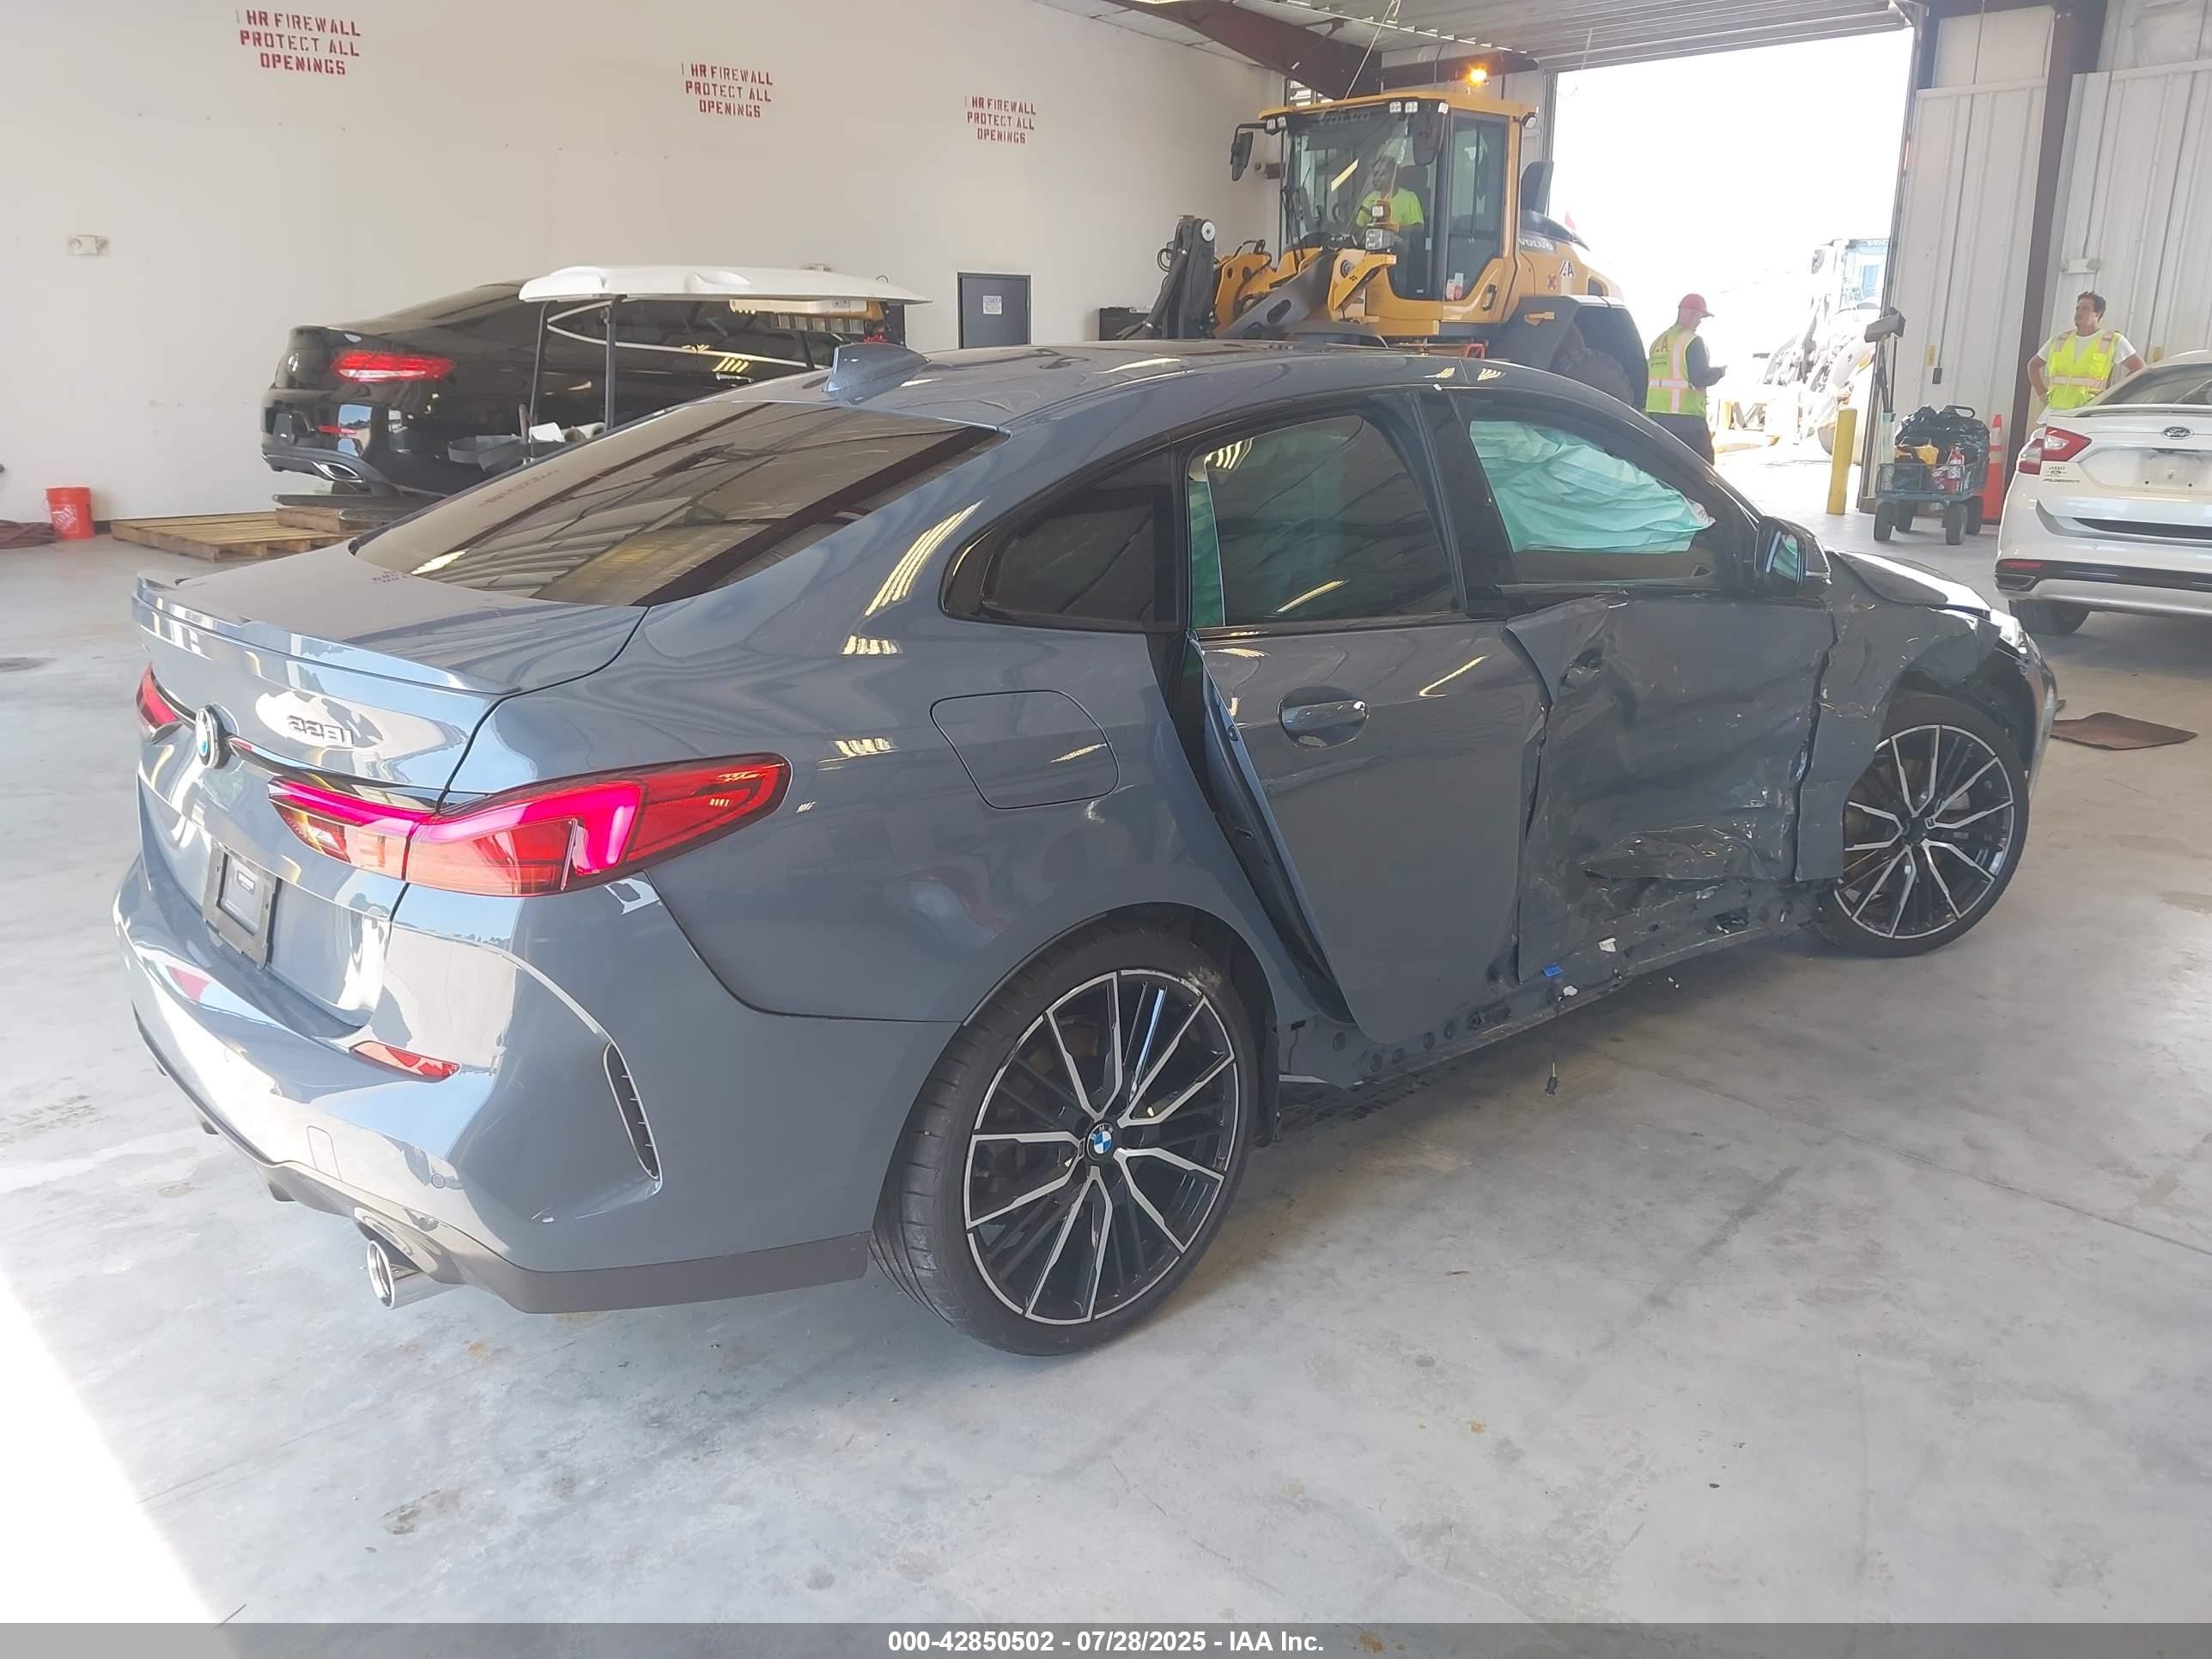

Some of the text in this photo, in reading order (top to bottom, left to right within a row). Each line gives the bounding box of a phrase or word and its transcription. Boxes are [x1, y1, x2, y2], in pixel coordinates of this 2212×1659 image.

[246, 9, 269, 27] HR
[274, 12, 362, 37] FIREWALL
[240, 29, 360, 57] PROTECT ALL
[260, 52, 345, 76] OPENINGS
[691, 64, 707, 77] HR
[710, 65, 774, 86] FIREWALL
[685, 80, 772, 102] PROTECT ALL
[699, 99, 761, 118] OPENINGS
[971, 95, 984, 109] HR
[987, 98, 1036, 115] FIREWALL
[967, 111, 1035, 131] PROTECT ALL
[977, 127, 1025, 144] OPENINGS
